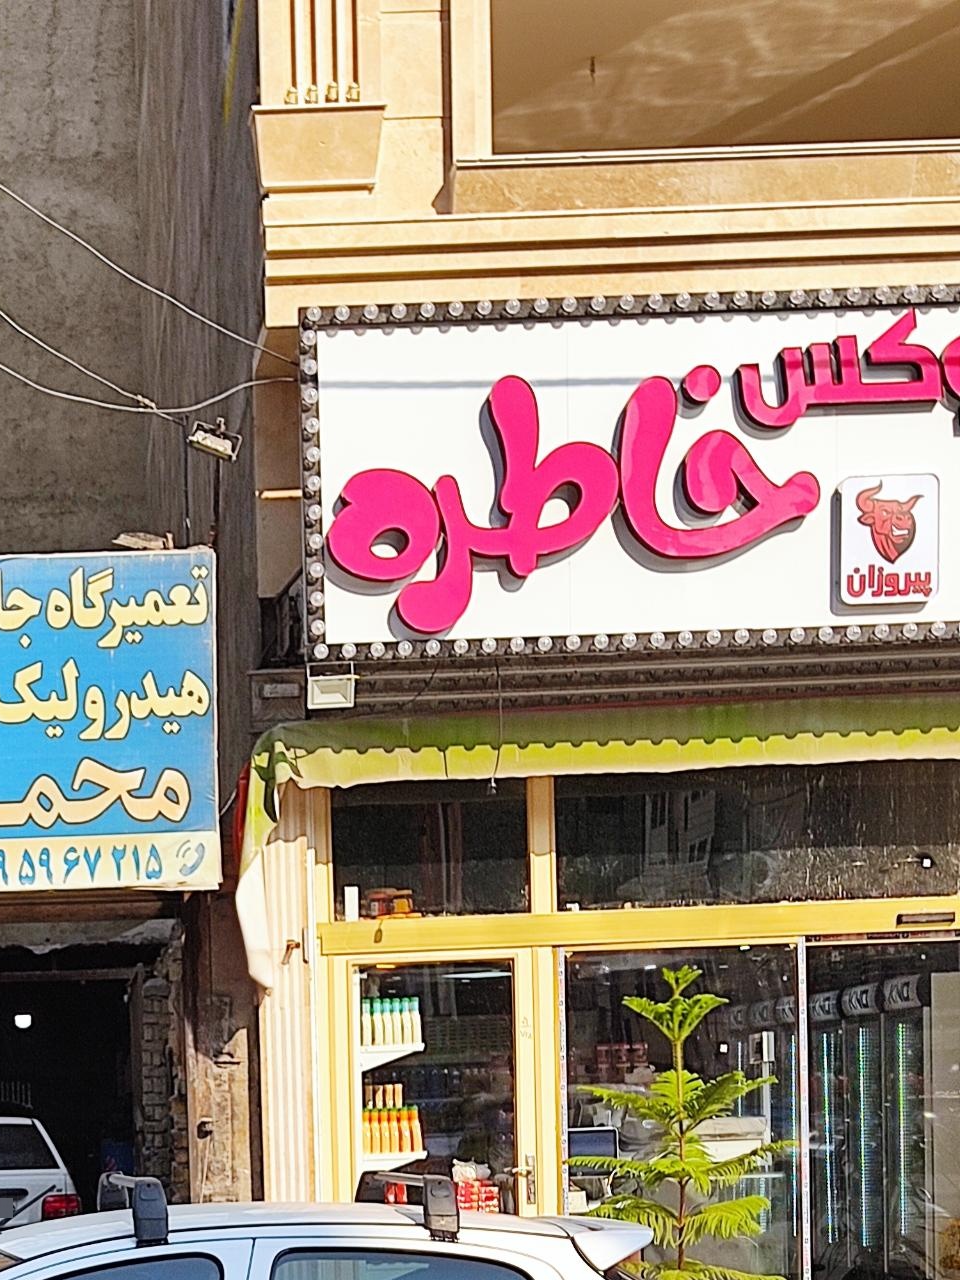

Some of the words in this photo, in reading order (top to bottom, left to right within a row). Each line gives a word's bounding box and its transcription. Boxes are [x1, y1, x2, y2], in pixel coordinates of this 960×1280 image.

[740, 307, 960, 430] کس
[326, 364, 821, 634] خاطره
[45, 564, 209, 648] تعمیرگاه
[846, 564, 933, 598] پیروزان
[19, 845, 53, 886] ۵۹
[63, 845, 103, 884] ۶۷
[111, 843, 164, 882] ۲۱۵
